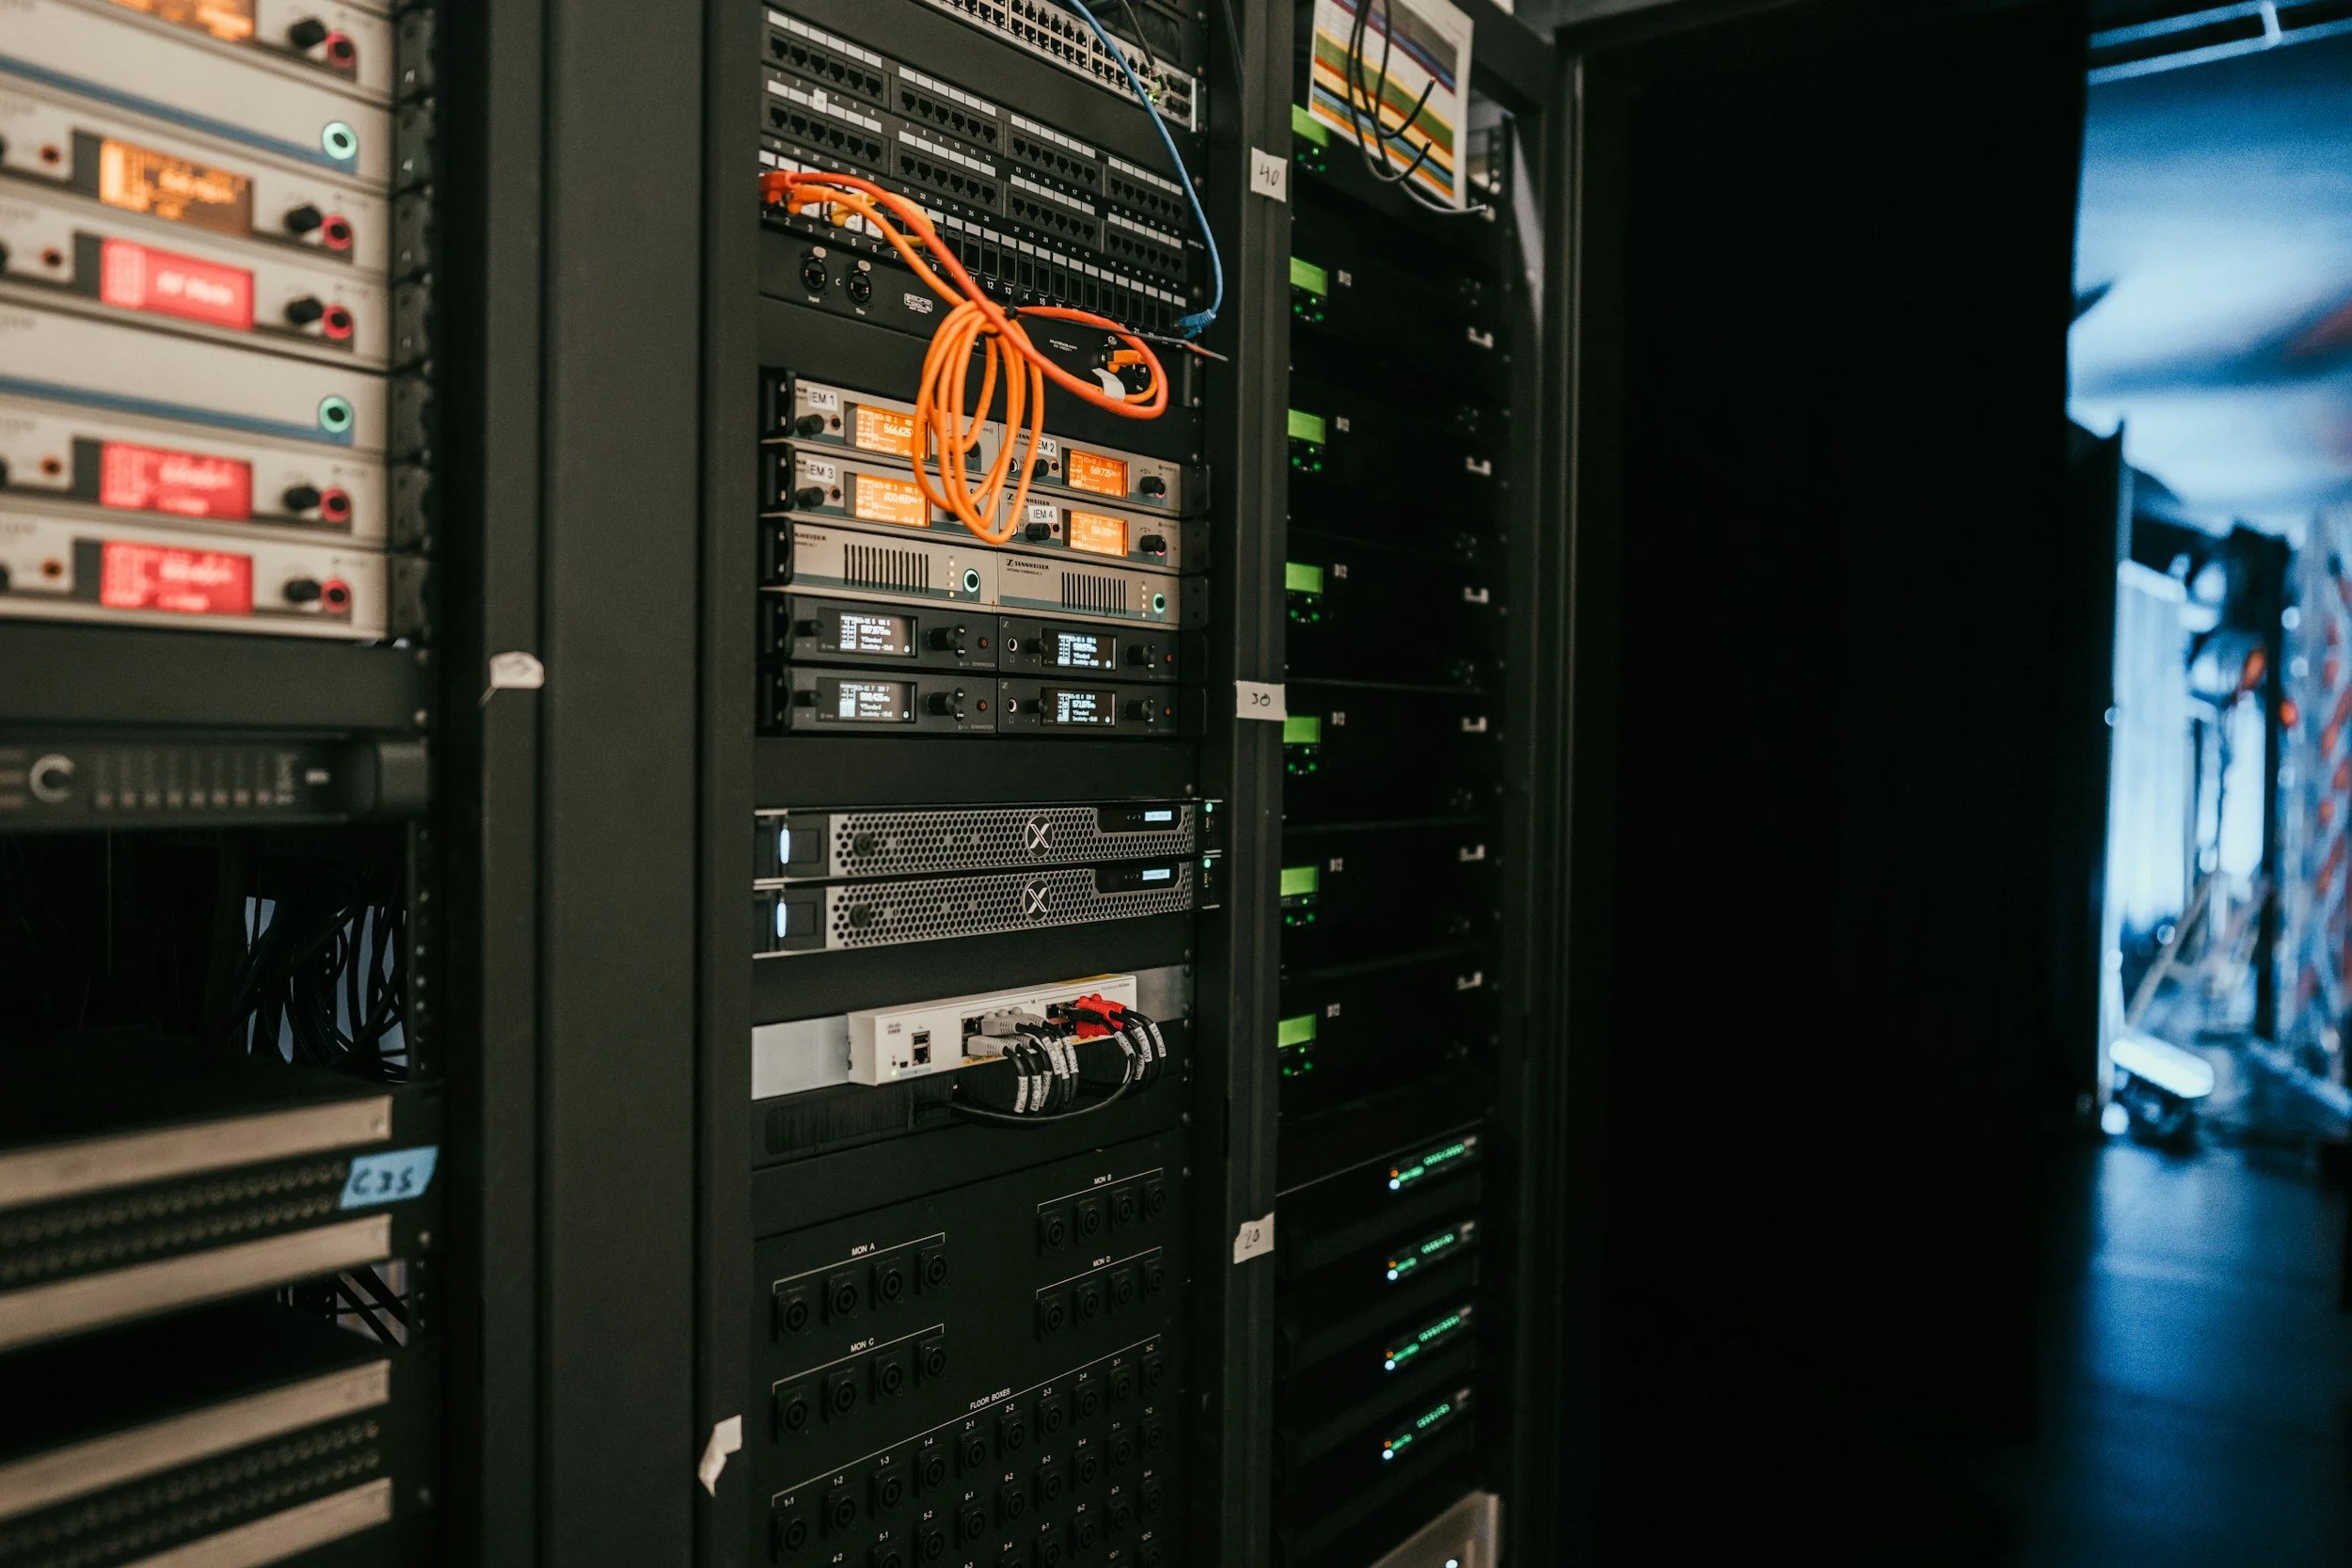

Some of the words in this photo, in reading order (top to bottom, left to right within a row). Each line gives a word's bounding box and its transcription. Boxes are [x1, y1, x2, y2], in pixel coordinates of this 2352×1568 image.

[1260, 163, 1279, 186] 40
[785, 217, 790, 226] 2
[808, 224, 813, 232] 3
[851, 238, 856, 246] 5
[932, 263, 937, 272] 9
[987, 281, 993, 290] 12
[1005, 287, 1011, 295] 13
[1040, 297, 1046, 306] 15
[830, 395, 834, 406] 1
[1038, 440, 1048, 451] EM
[1050, 443, 1055, 452] 2
[828, 468, 834, 479] 3
[1026, 498, 1050, 506] NHEISER
[1033, 509, 1046, 519] IEM
[1049, 510, 1053, 518] 4
[1015, 561, 1049, 570] SENNHEISER
[1251, 692, 1271, 706] 30
[1094, 1176, 1106, 1184] MON
[851, 1244, 867, 1256] MON
[1093, 1259, 1104, 1267] MON
[850, 1341, 866, 1352] MON
[868, 1338, 874, 1346] C
[970, 1396, 989, 1410] FLOOR
[992, 1387, 1010, 1401] BOXES
[784, 1497, 794, 1507] 1-1
[834, 1476, 844, 1486] 1-2
[881, 1456, 889, 1465] 1-3
[925, 1438, 933, 1447] 1-4
[1006, 1403, 1014, 1413] 2-2
[1043, 1387, 1052, 1397] 2-3
[833, 1553, 842, 1562] 4-2
[880, 1531, 888, 1541] 5-1
[923, 1511, 932, 1520] 5-2
[1005, 1473, 1013, 1481] 6-2
